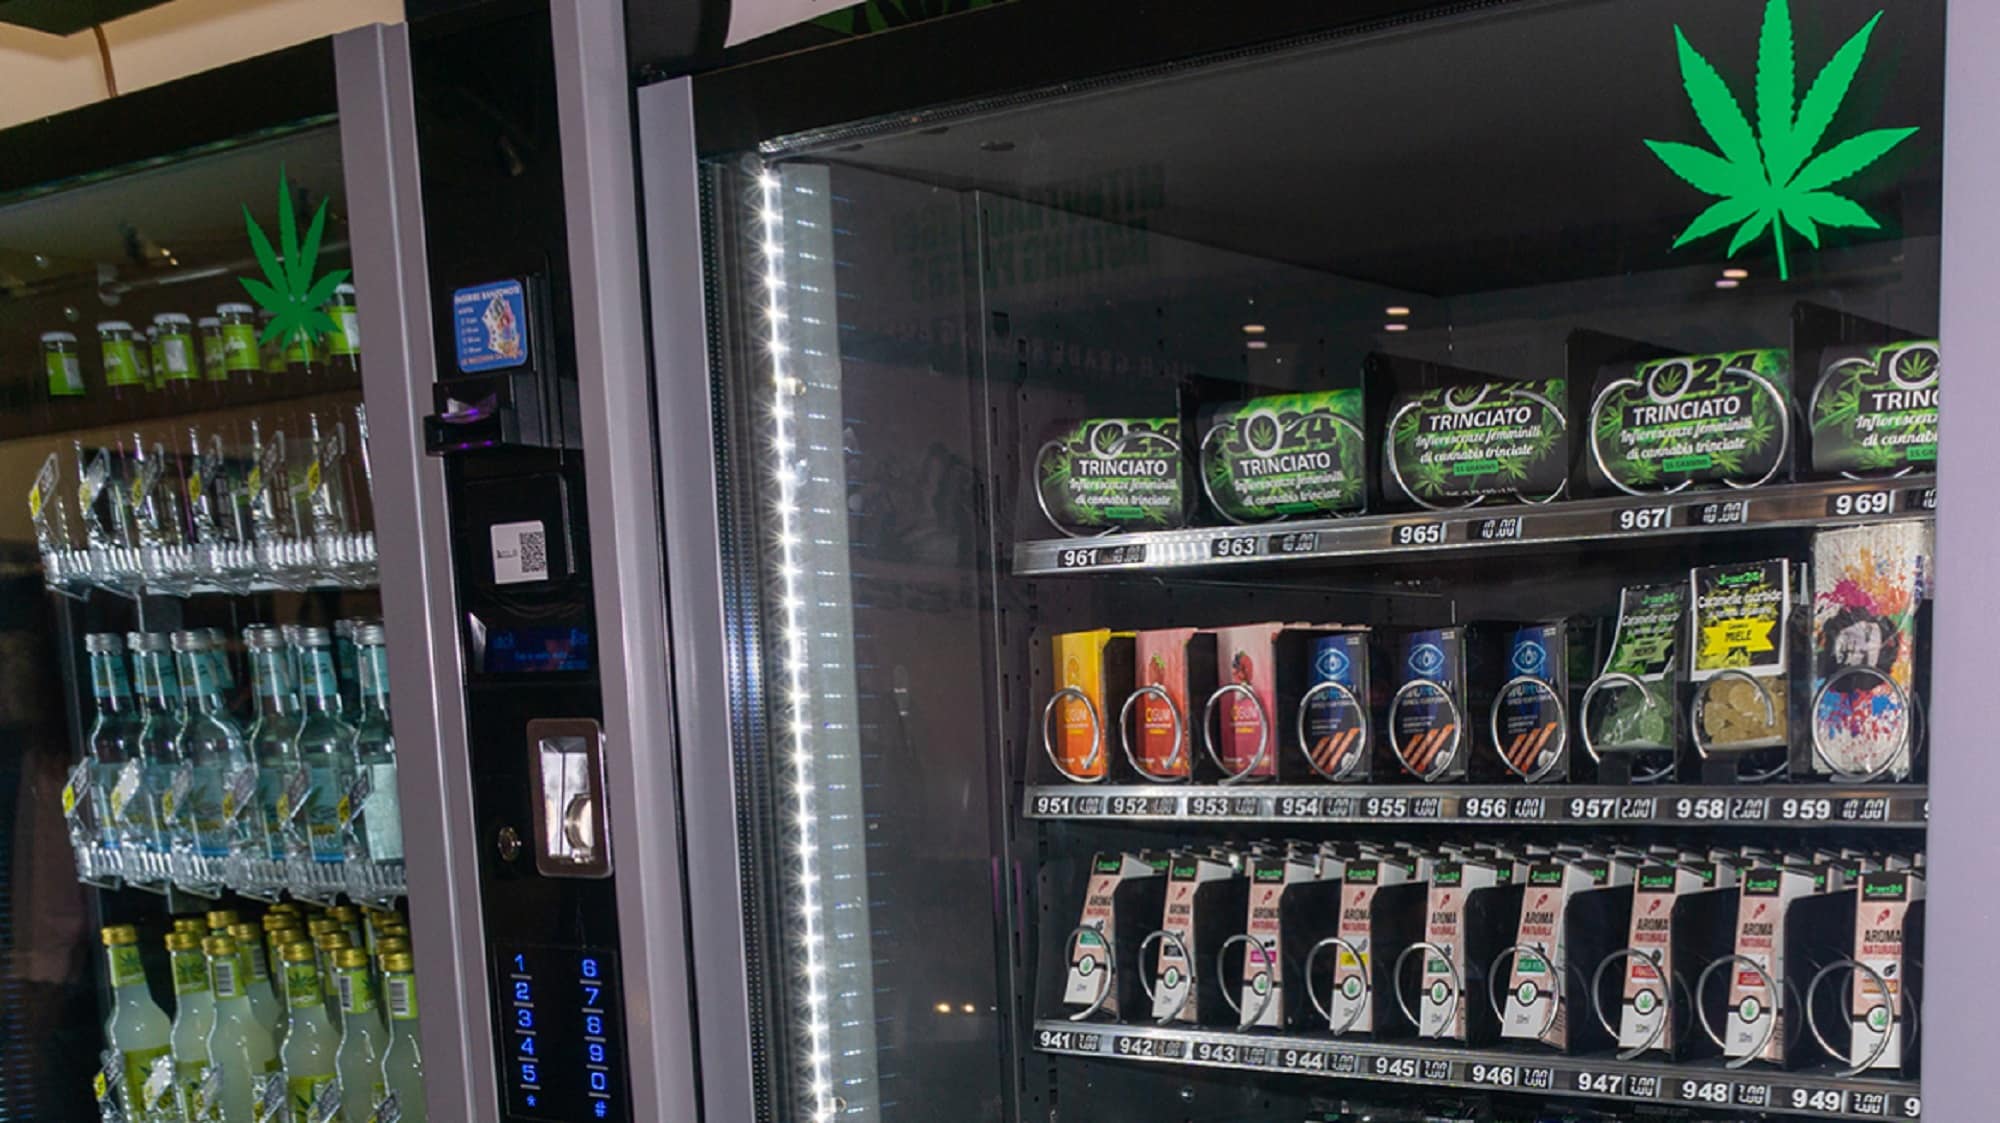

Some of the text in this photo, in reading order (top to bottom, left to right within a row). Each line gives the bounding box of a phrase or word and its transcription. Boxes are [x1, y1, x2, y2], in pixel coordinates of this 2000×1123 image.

[1429, 406, 1532, 431] TRINCIATO
[1633, 396, 1741, 425] TRINCIATO
[1862, 433, 1879, 448] di
[1239, 452, 1331, 476] TRINCIATO
[1434, 448, 1484, 462] cannabis
[1078, 459, 1169, 476] TRINCIATO
[1836, 492, 1888, 515] 969
[1620, 502, 1742, 529] 967 10.00
[1400, 518, 1516, 544] 965 10.00
[1218, 538, 1255, 556] 963
[1064, 549, 1097, 566] 961
[1038, 797, 1070, 814] 951
[1114, 797, 1147, 815] 952
[1193, 798, 1228, 815] 953
[1283, 798, 1318, 815] 954
[1368, 798, 1406, 816] 955
[1466, 798, 1506, 818] 956
[1571, 798, 1651, 818] 957 2.00
[1677, 798, 1763, 818] 958 2.00
[1782, 798, 1884, 819] 959 10.00
[1524, 911, 1554, 925] AROMA
[1636, 917, 1668, 931] AROMA
[1742, 922, 1773, 936] AROMA
[1864, 929, 1903, 943] AROMA
[514, 954, 524, 971] 1
[582, 959, 597, 977] 6
[515, 982, 529, 1000] 2
[584, 987, 599, 1005] 7
[517, 1009, 532, 1026] 3
[586, 1016, 600, 1034] 8
[521, 1037, 534, 1055] 4
[1040, 1031, 1070, 1049] 941
[1119, 1037, 1152, 1056] 942
[589, 1044, 603, 1062] 9
[1199, 1044, 1235, 1062] 943
[1285, 1051, 1322, 1069] 944
[522, 1065, 536, 1082] 5
[1376, 1057, 1414, 1077] 945
[1473, 1065, 1513, 1085] 946
[591, 1072, 605, 1090] 0
[1578, 1072, 1622, 1093] 947
[1682, 1080, 1727, 1102] 948
[1792, 1088, 1840, 1110] 949
